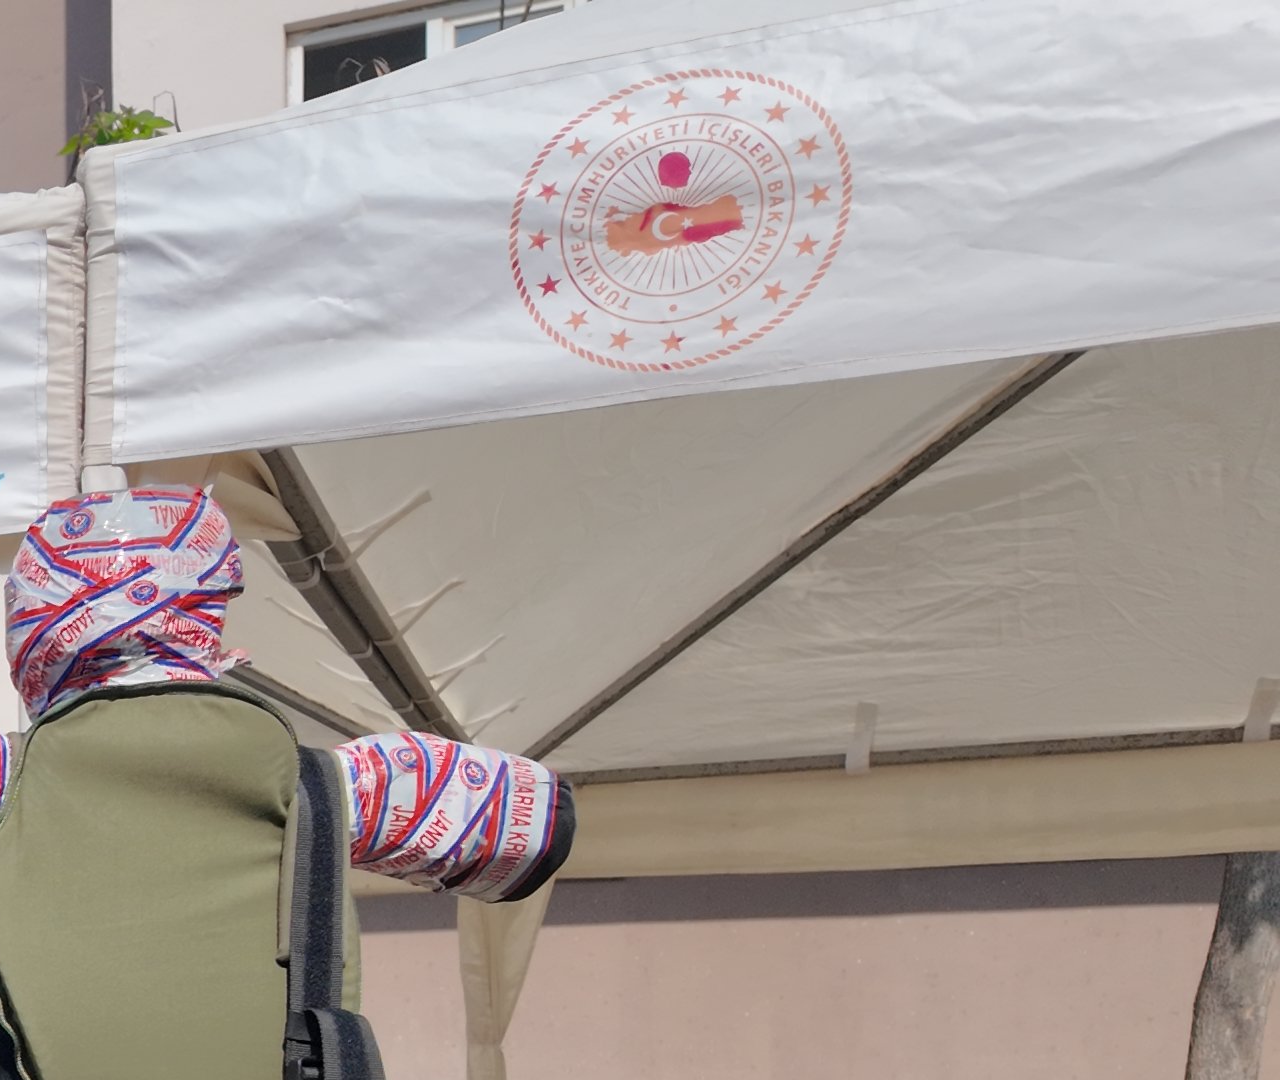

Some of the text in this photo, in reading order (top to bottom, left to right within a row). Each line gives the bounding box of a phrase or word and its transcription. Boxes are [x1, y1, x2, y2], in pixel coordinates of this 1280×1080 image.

[570, 118, 785, 311] TÜRKİYE CUMHURİYETİ İÇİŞLERİ BAKANLIĞI
